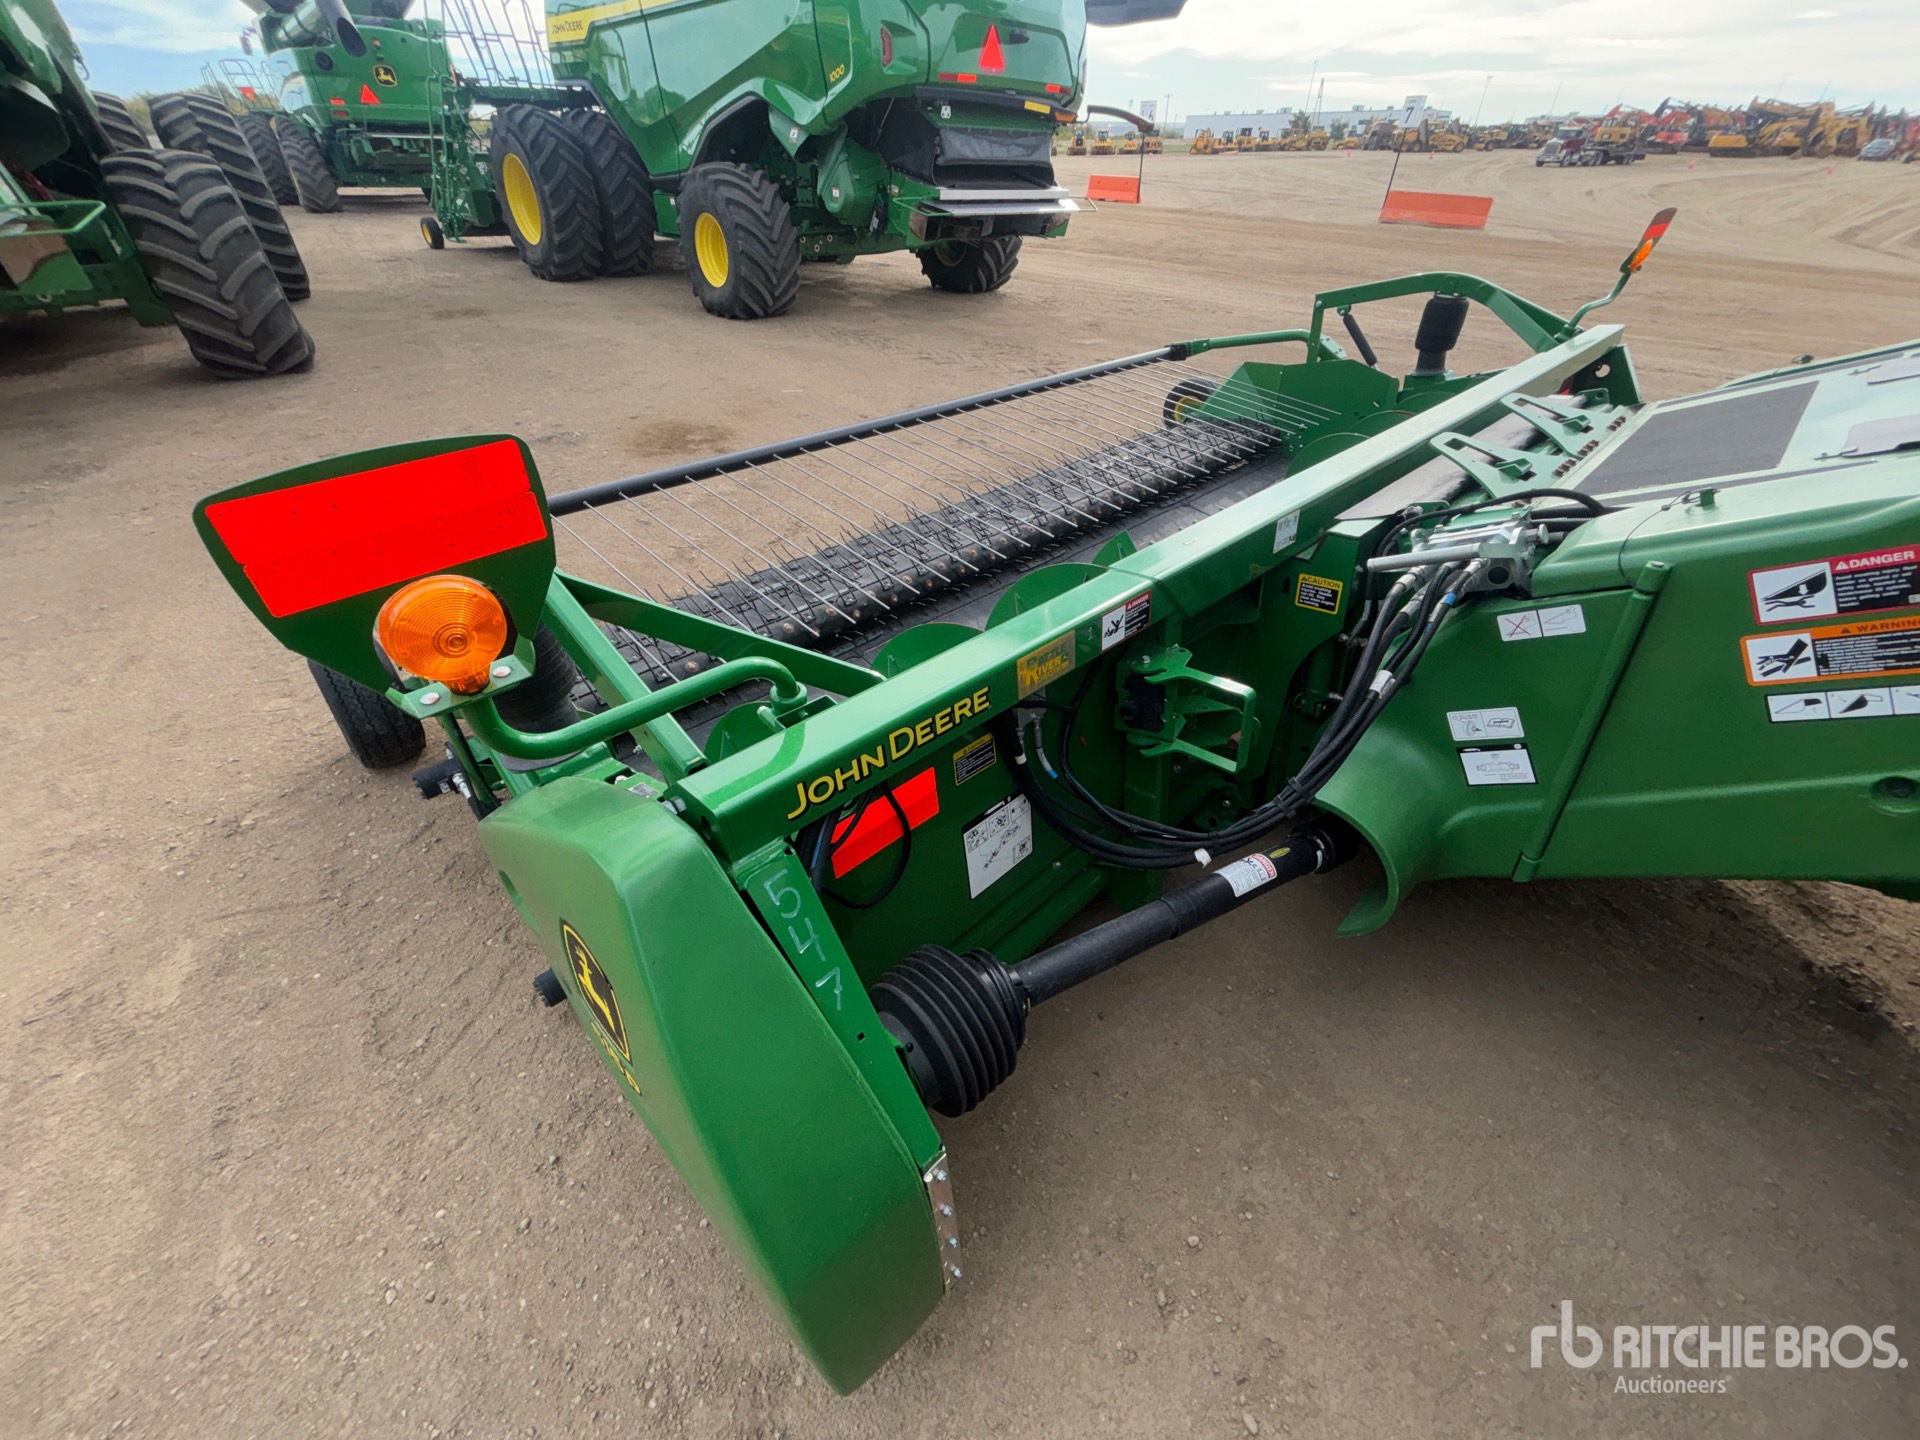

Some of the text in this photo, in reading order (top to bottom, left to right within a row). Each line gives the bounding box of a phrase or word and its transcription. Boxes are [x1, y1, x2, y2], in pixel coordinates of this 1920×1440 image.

[552, 20, 583, 34] JOHN DEERE
[829, 64, 845, 83] 1000
[1405, 106, 1415, 124] 7
[1849, 551, 1915, 568] DANGER
[1308, 576, 1341, 589] CAUTION
[787, 744, 885, 820] JOHN
[888, 686, 990, 761] DEERE
